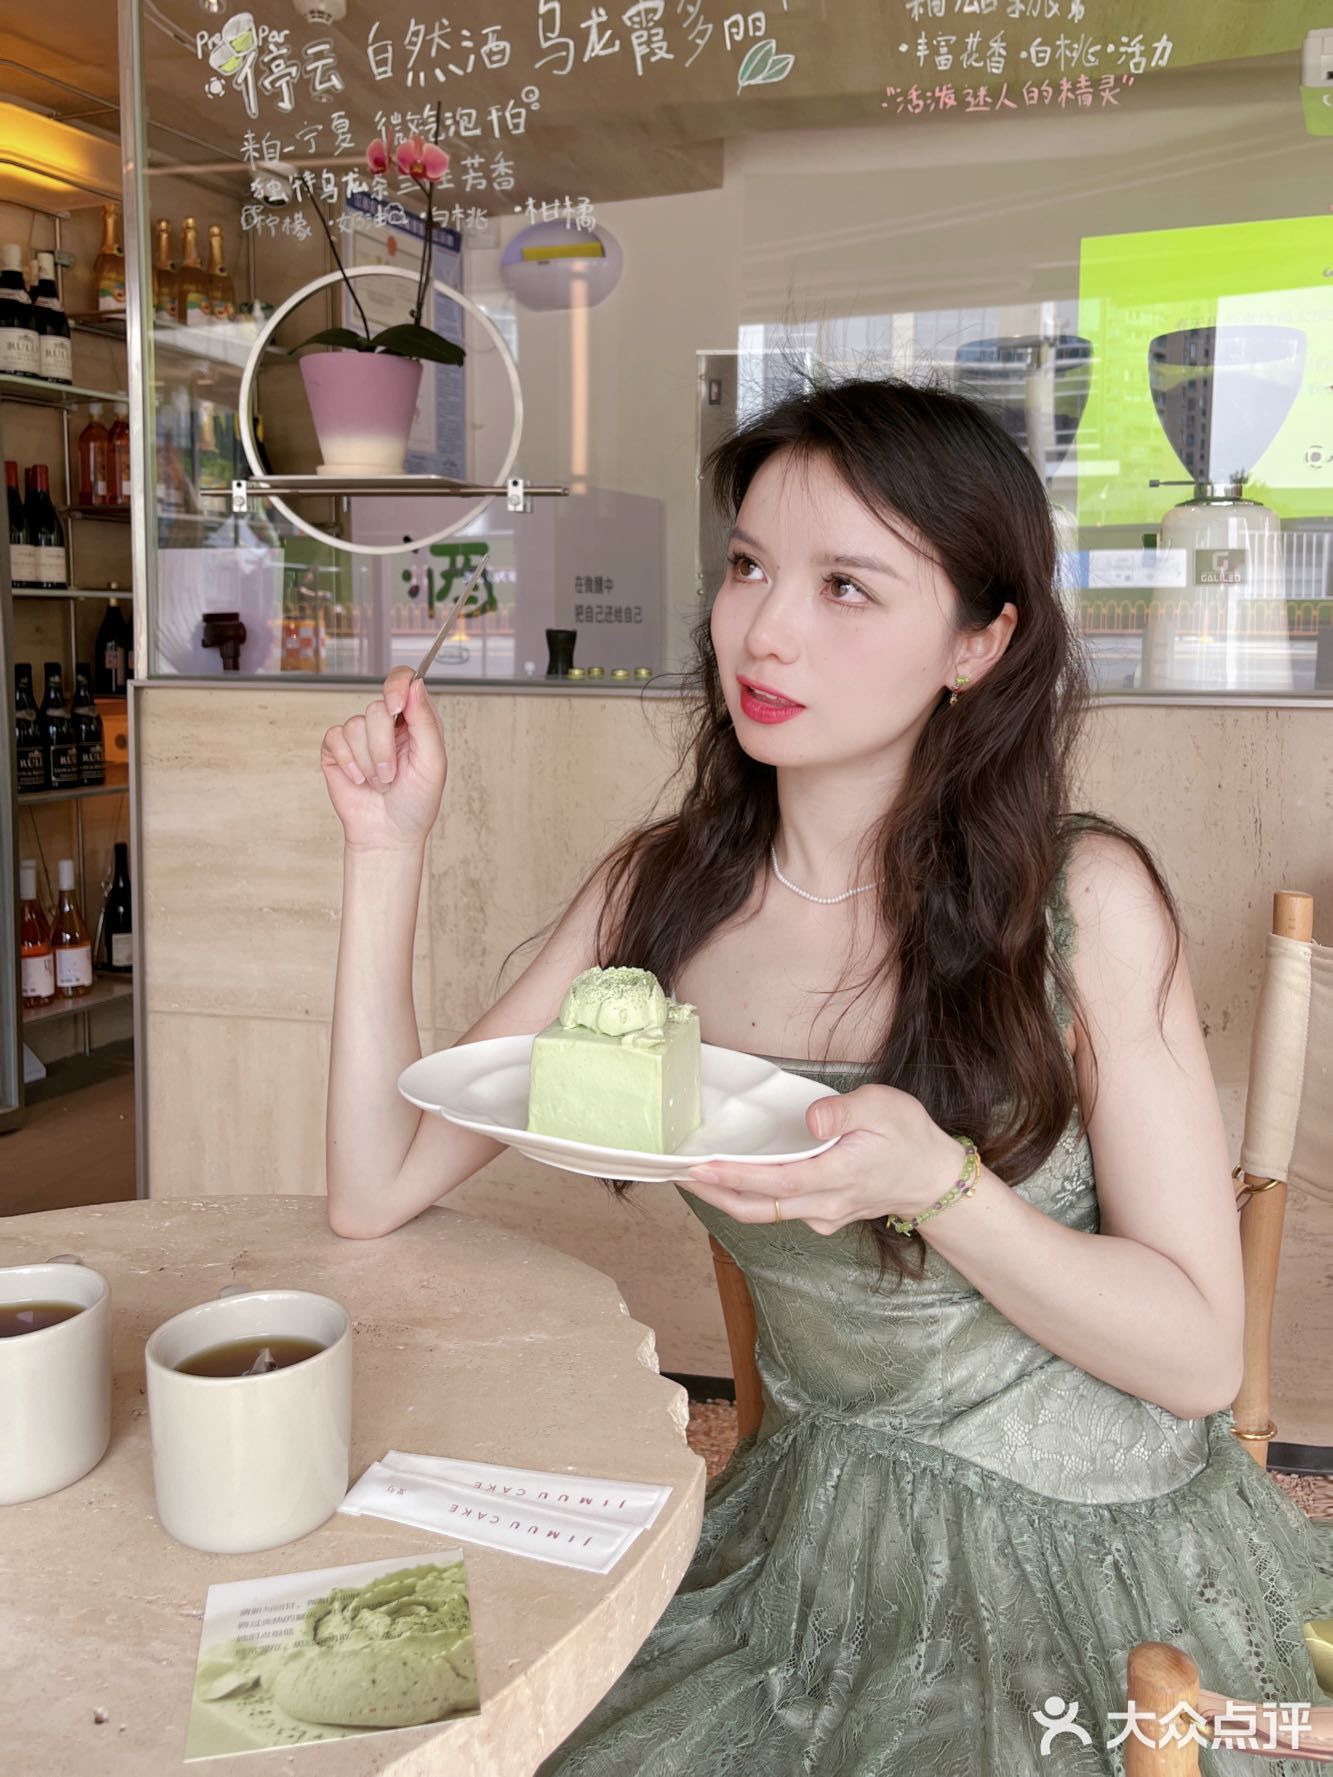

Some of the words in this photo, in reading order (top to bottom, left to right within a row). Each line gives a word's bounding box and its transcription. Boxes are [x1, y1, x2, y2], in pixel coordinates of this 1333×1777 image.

[366, 18, 512, 88] 自然酒
[233, 39, 344, 118] 停云
[472, 1481, 527, 1497] CAKE
[538, 1491, 627, 1509] JIMUU
[447, 1503, 501, 1525] CAKE
[509, 1520, 593, 1547] JIMUU
